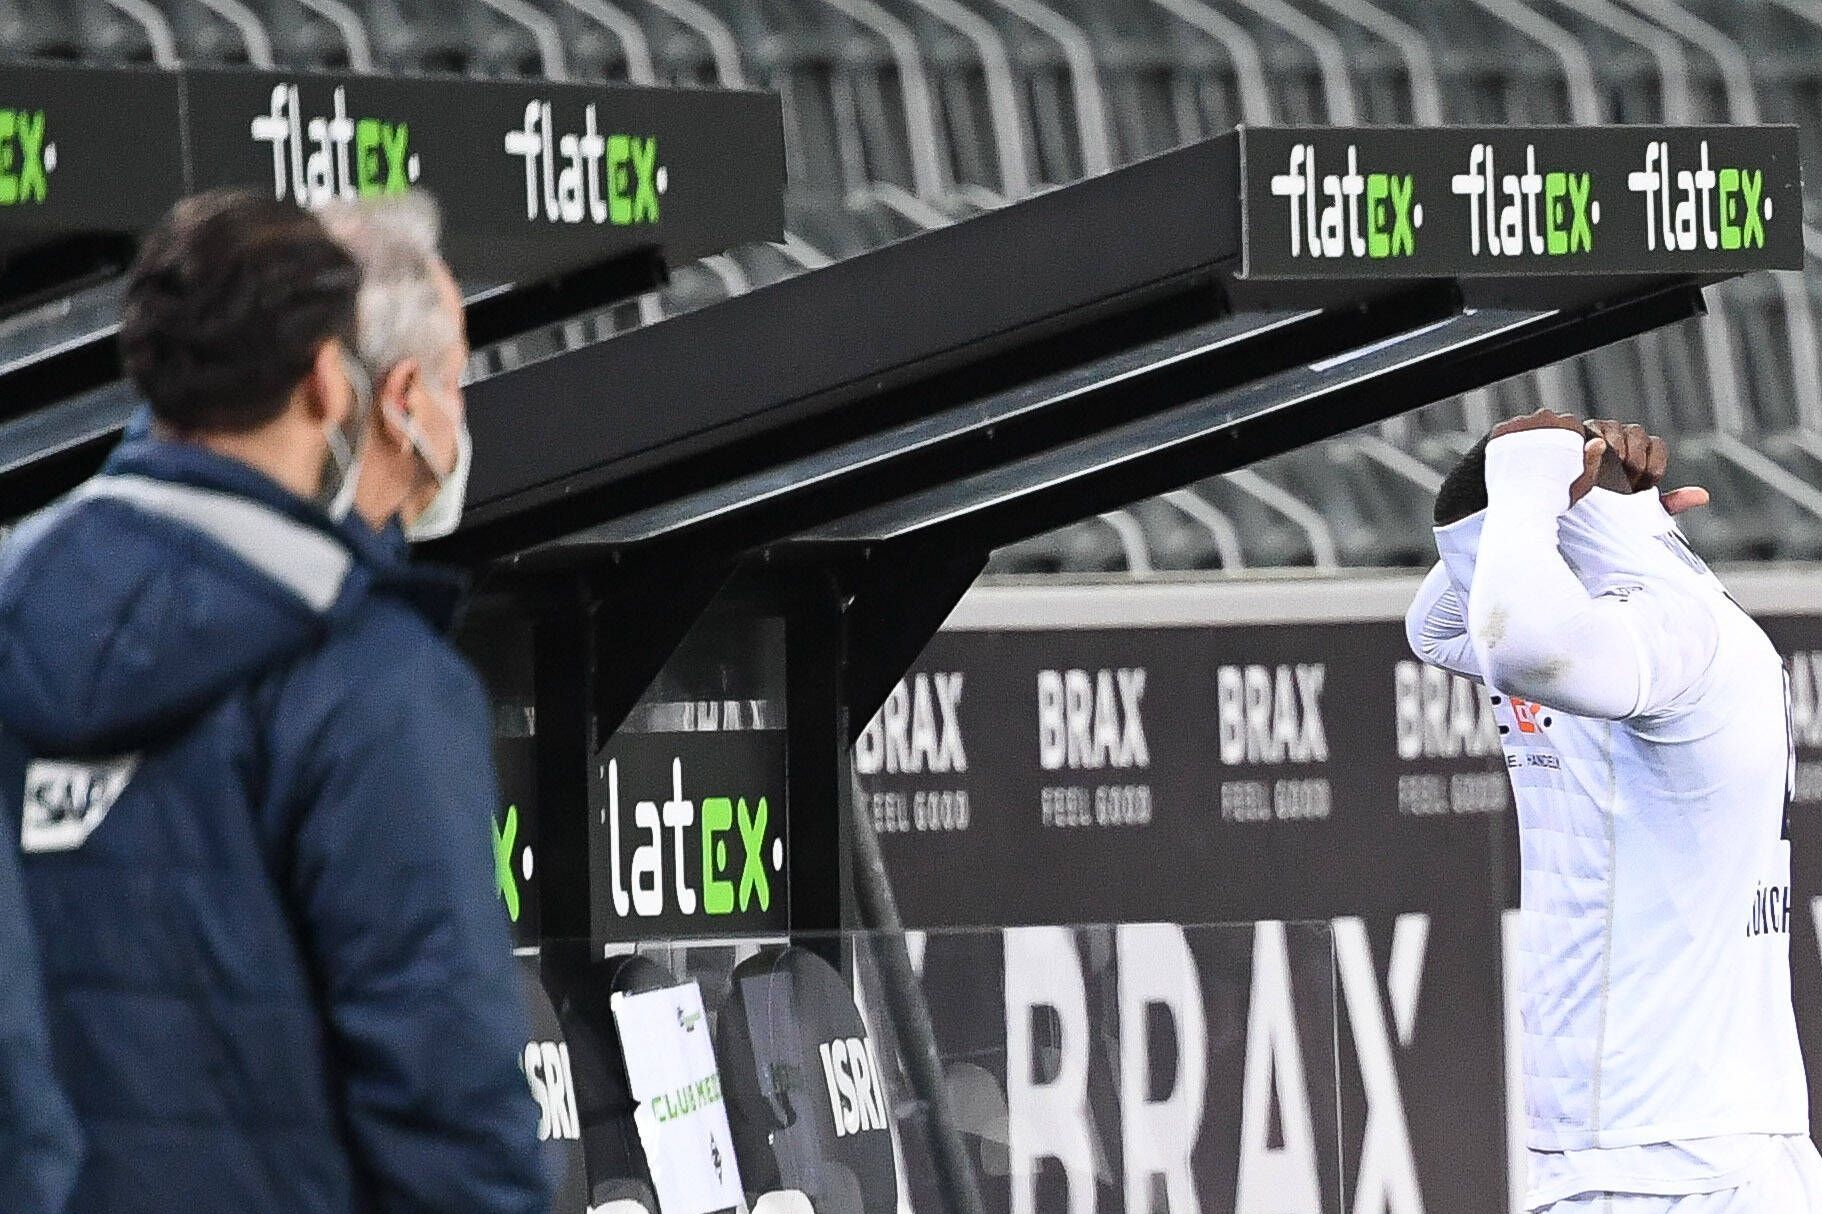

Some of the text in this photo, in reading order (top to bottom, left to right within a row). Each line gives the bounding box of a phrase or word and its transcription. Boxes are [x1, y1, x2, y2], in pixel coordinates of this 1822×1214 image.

[1038, 668, 1150, 770] BRAX
[1217, 664, 1328, 765] BRAX
[519, 1041, 580, 1140] SRI
[819, 1037, 888, 1137] ISRI
